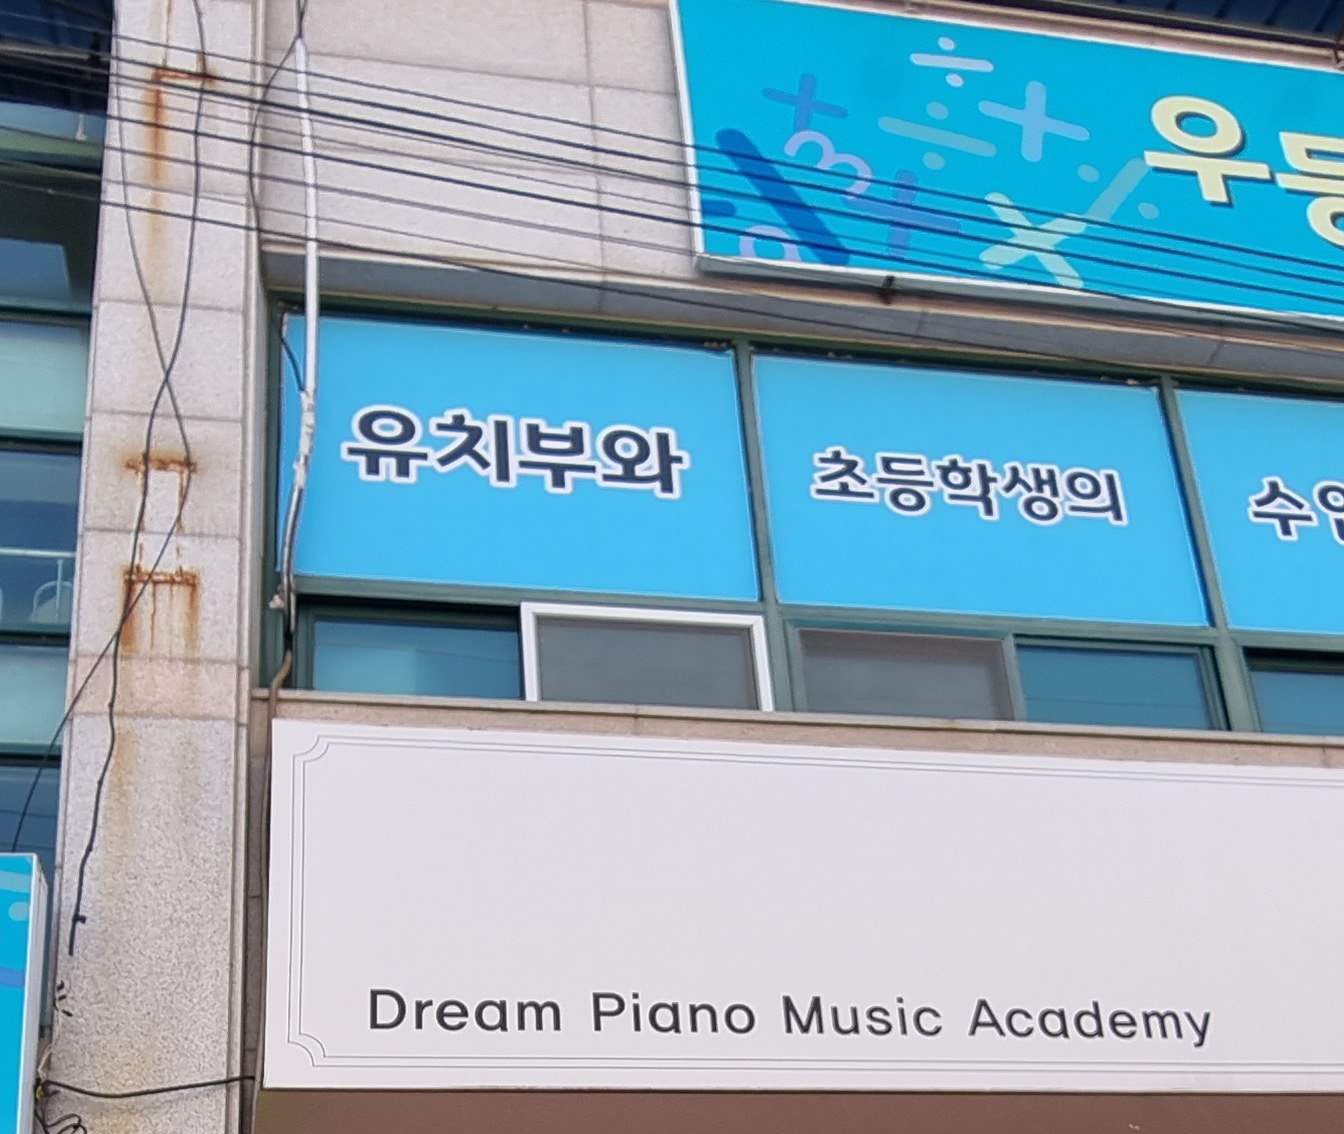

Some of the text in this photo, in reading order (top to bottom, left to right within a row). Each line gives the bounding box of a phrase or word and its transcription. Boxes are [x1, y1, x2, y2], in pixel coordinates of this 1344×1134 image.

[344, 405, 689, 499] 유치부와
[811, 445, 1130, 525] 초등학생의
[368, 989, 1212, 1048] Dream Piano Music Academy
